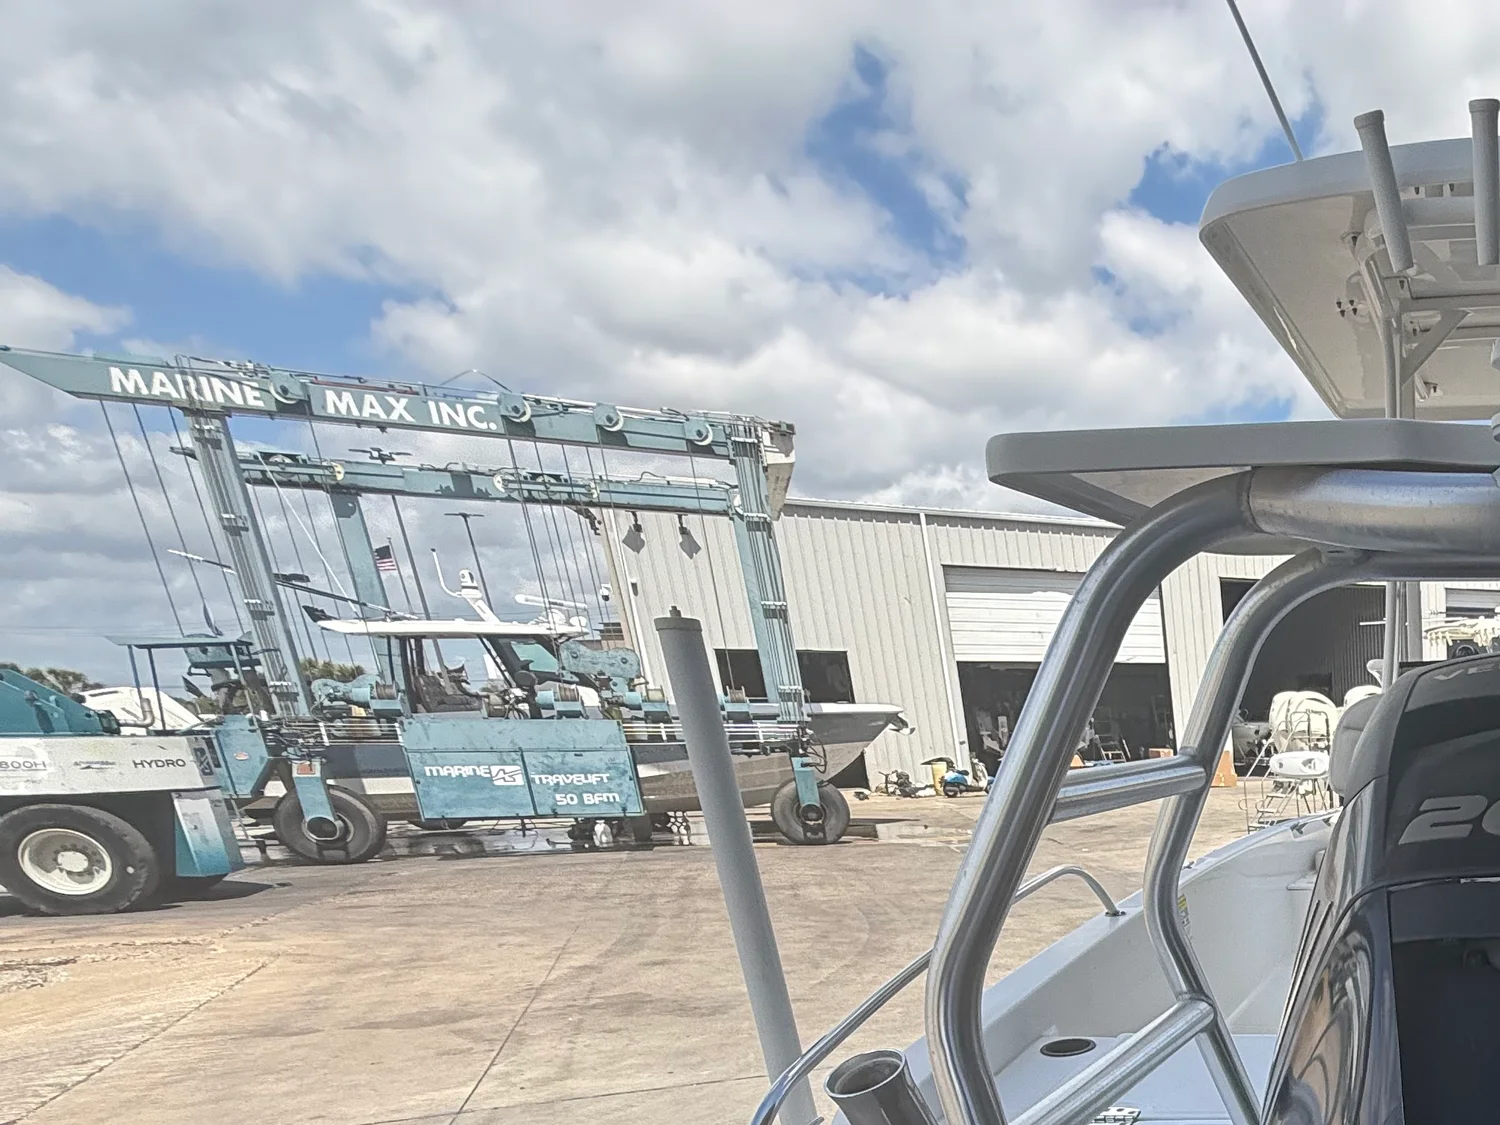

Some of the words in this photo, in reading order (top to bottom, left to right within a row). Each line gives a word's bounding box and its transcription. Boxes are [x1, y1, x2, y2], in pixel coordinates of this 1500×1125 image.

[108, 366, 265, 408] MARINE
[324, 389, 416, 423] MAX
[428, 400, 498, 431] INC.
[132, 757, 186, 769] HYDRO
[424, 765, 491, 778] MARINE
[531, 772, 610, 786] TRAVELIFT
[556, 793, 578, 806] 50
[583, 792, 620, 805] BFM
